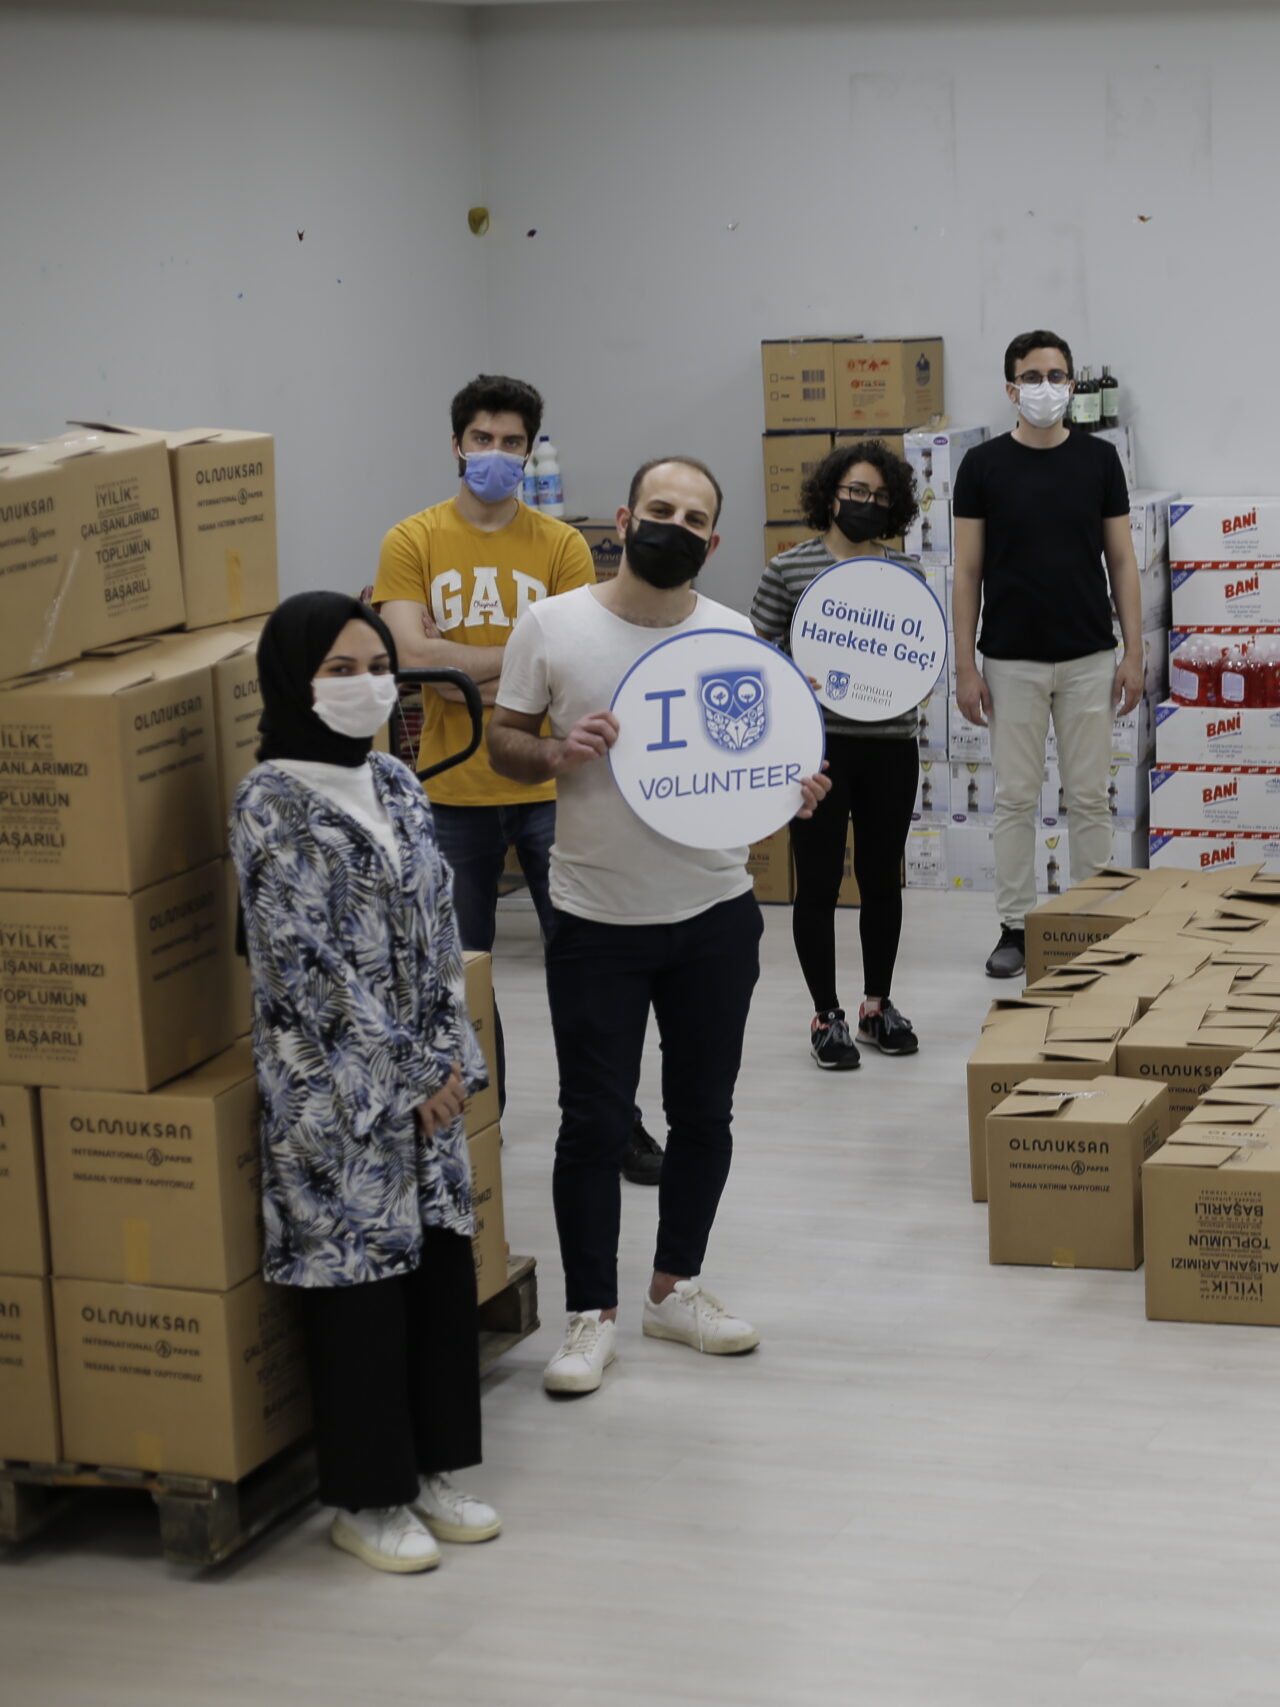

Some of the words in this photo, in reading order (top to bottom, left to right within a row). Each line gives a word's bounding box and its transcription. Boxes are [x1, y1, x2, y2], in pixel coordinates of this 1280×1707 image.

[96, 487, 132, 507] İYİLİK
[0, 497, 54, 523] MUKSAN
[81, 508, 159, 540] ÇALIŞANLARIMIZI
[96, 539, 151, 565] TOPLUMUN
[104, 579, 151, 603] BAŞARILI
[821, 599, 895, 632] Gönüllü
[901, 618, 925, 642] Ol,
[801, 620, 888, 657] Harekete
[893, 643, 936, 671] Geç!
[645, 689, 687, 751] I
[0, 730, 40, 749] İLİK
[0, 762, 88, 778] ANLARIMIZI
[639, 763, 802, 800] VOLUNTEER
[0, 792, 70, 808] PLUMUN
[0, 831, 65, 849] AŞARILI
[1043, 931, 1110, 943] OLMUKSA
[0, 960, 104, 978] IŞANLARIMIZI
[5, 1029, 82, 1046] BAŞARILI
[991, 1082, 1018, 1095] OL
[1168, 1086, 1198, 1095] TIONAL
[1009, 1138, 1109, 1154] OLMUKSAN
[1009, 1162, 1070, 1172] INTERNATIONAL
[1086, 1165, 1109, 1173] PAPER
[1194, 1202, 1263, 1217] BAŞARILI
[1188, 1234, 1271, 1250] TOPLUMUN
[1212, 1281, 1263, 1297] İYİLİK
